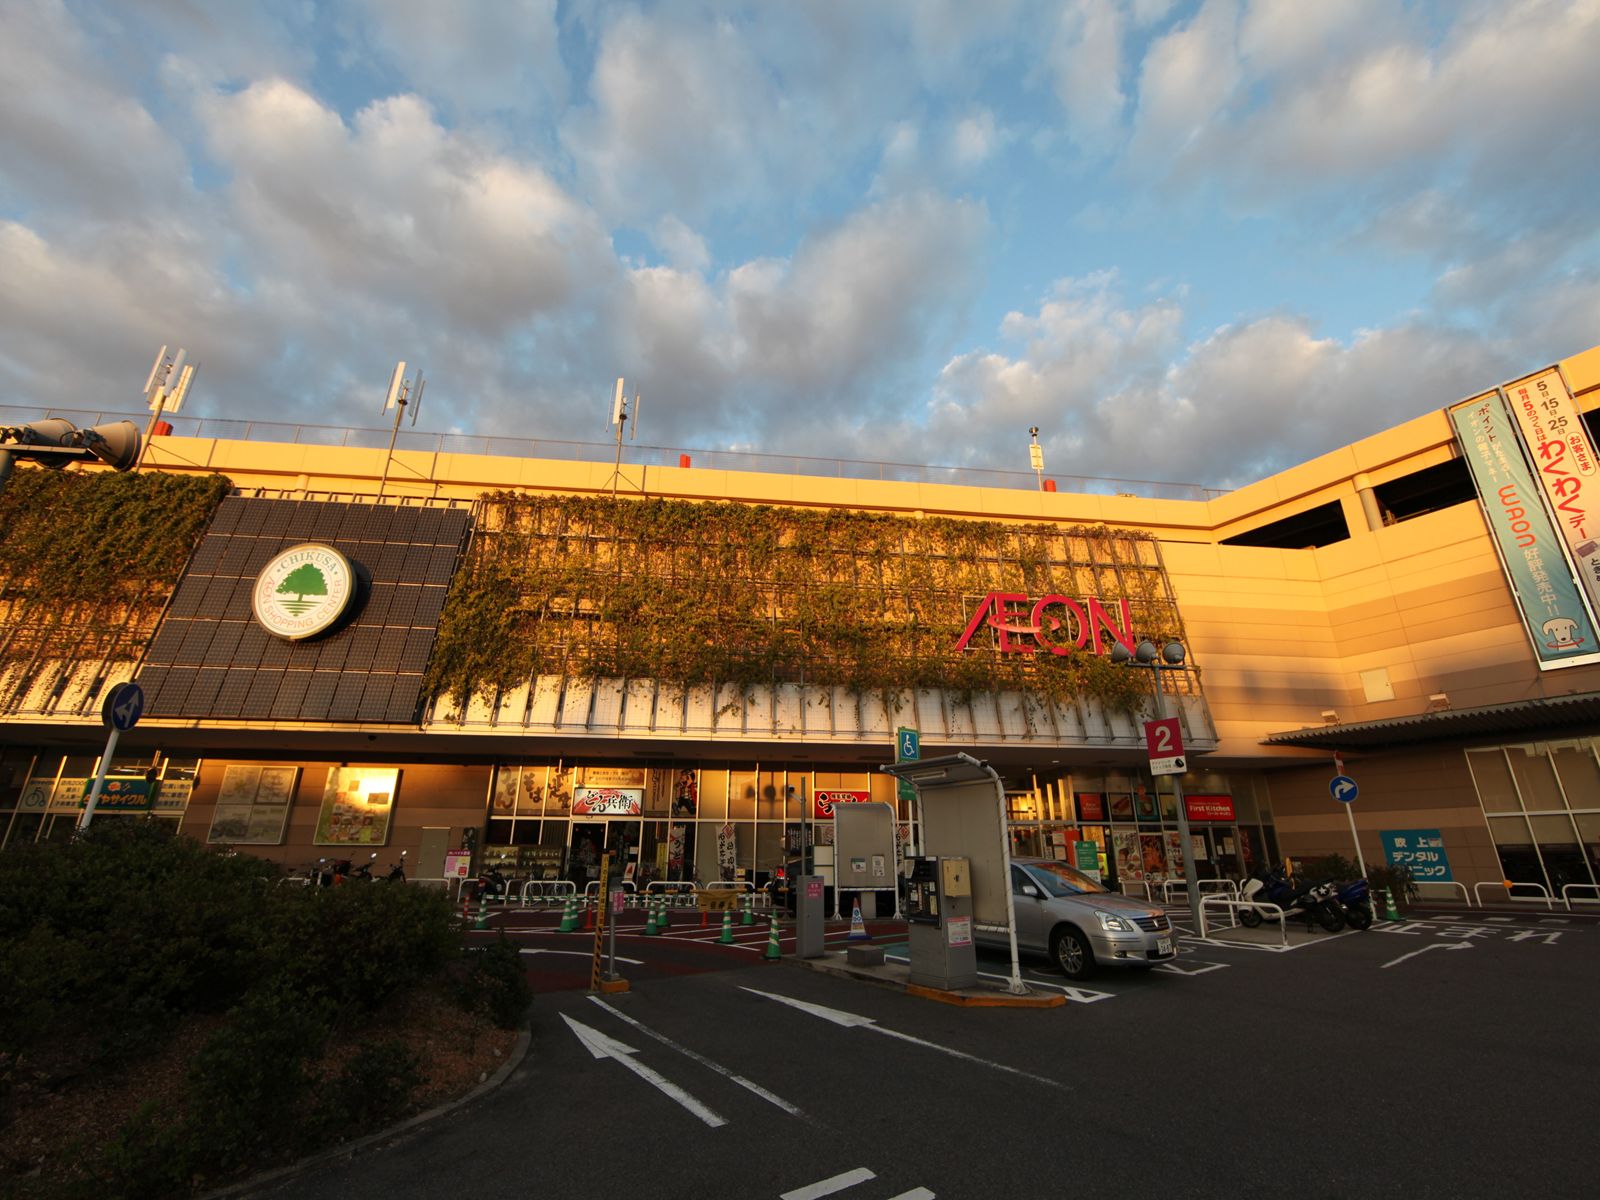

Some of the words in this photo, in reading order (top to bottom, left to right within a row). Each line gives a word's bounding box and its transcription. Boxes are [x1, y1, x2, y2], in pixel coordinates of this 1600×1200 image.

[1570, 435, 1592, 472] お客さま
[1538, 439, 1587, 540] わくわくデー
[280, 551, 337, 572] CHIKUSA
[264, 605, 314, 628] SHOPPING
[317, 579, 342, 620] CENTER
[1155, 726, 1174, 752] 2
[523, 772, 545, 803] そば
[585, 790, 633, 812] どん兵衛
[1189, 804, 1204, 812] First
[1205, 804, 1231, 812] Kitchen
[1392, 851, 1439, 862] デンタル
[1368, 920, 1563, 945] 止まれ
